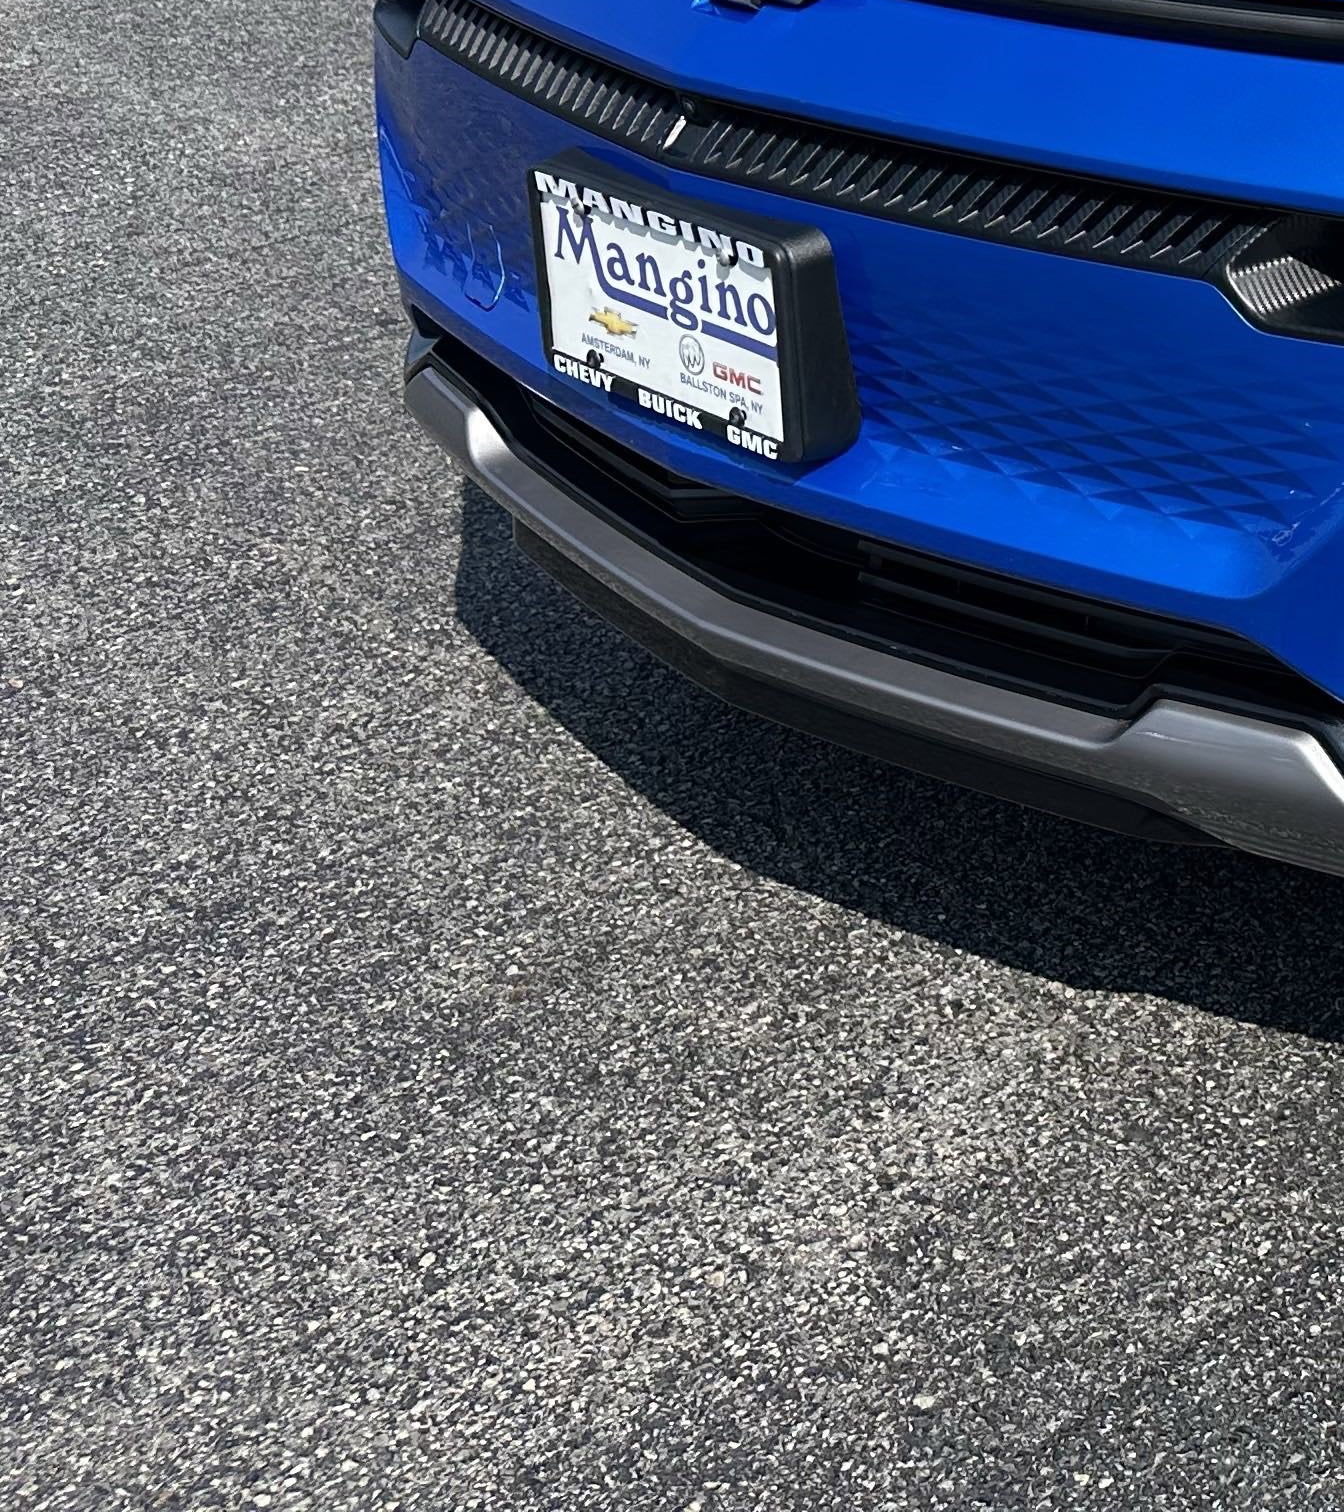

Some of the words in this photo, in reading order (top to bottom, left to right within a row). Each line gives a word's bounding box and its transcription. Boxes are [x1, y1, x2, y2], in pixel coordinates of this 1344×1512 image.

[534, 170, 765, 268] MANGINO
[553, 205, 777, 336] Mangino
[581, 333, 635, 367] AMSTERDAM,
[638, 355, 651, 369] NY
[553, 354, 616, 393] CHEVY
[680, 372, 727, 401] BALLSTON
[728, 390, 750, 412] SPA,
[750, 400, 763, 415] NY
[712, 361, 764, 395] GMC
[637, 387, 703, 430] BUICK
[726, 424, 778, 460] GMC
